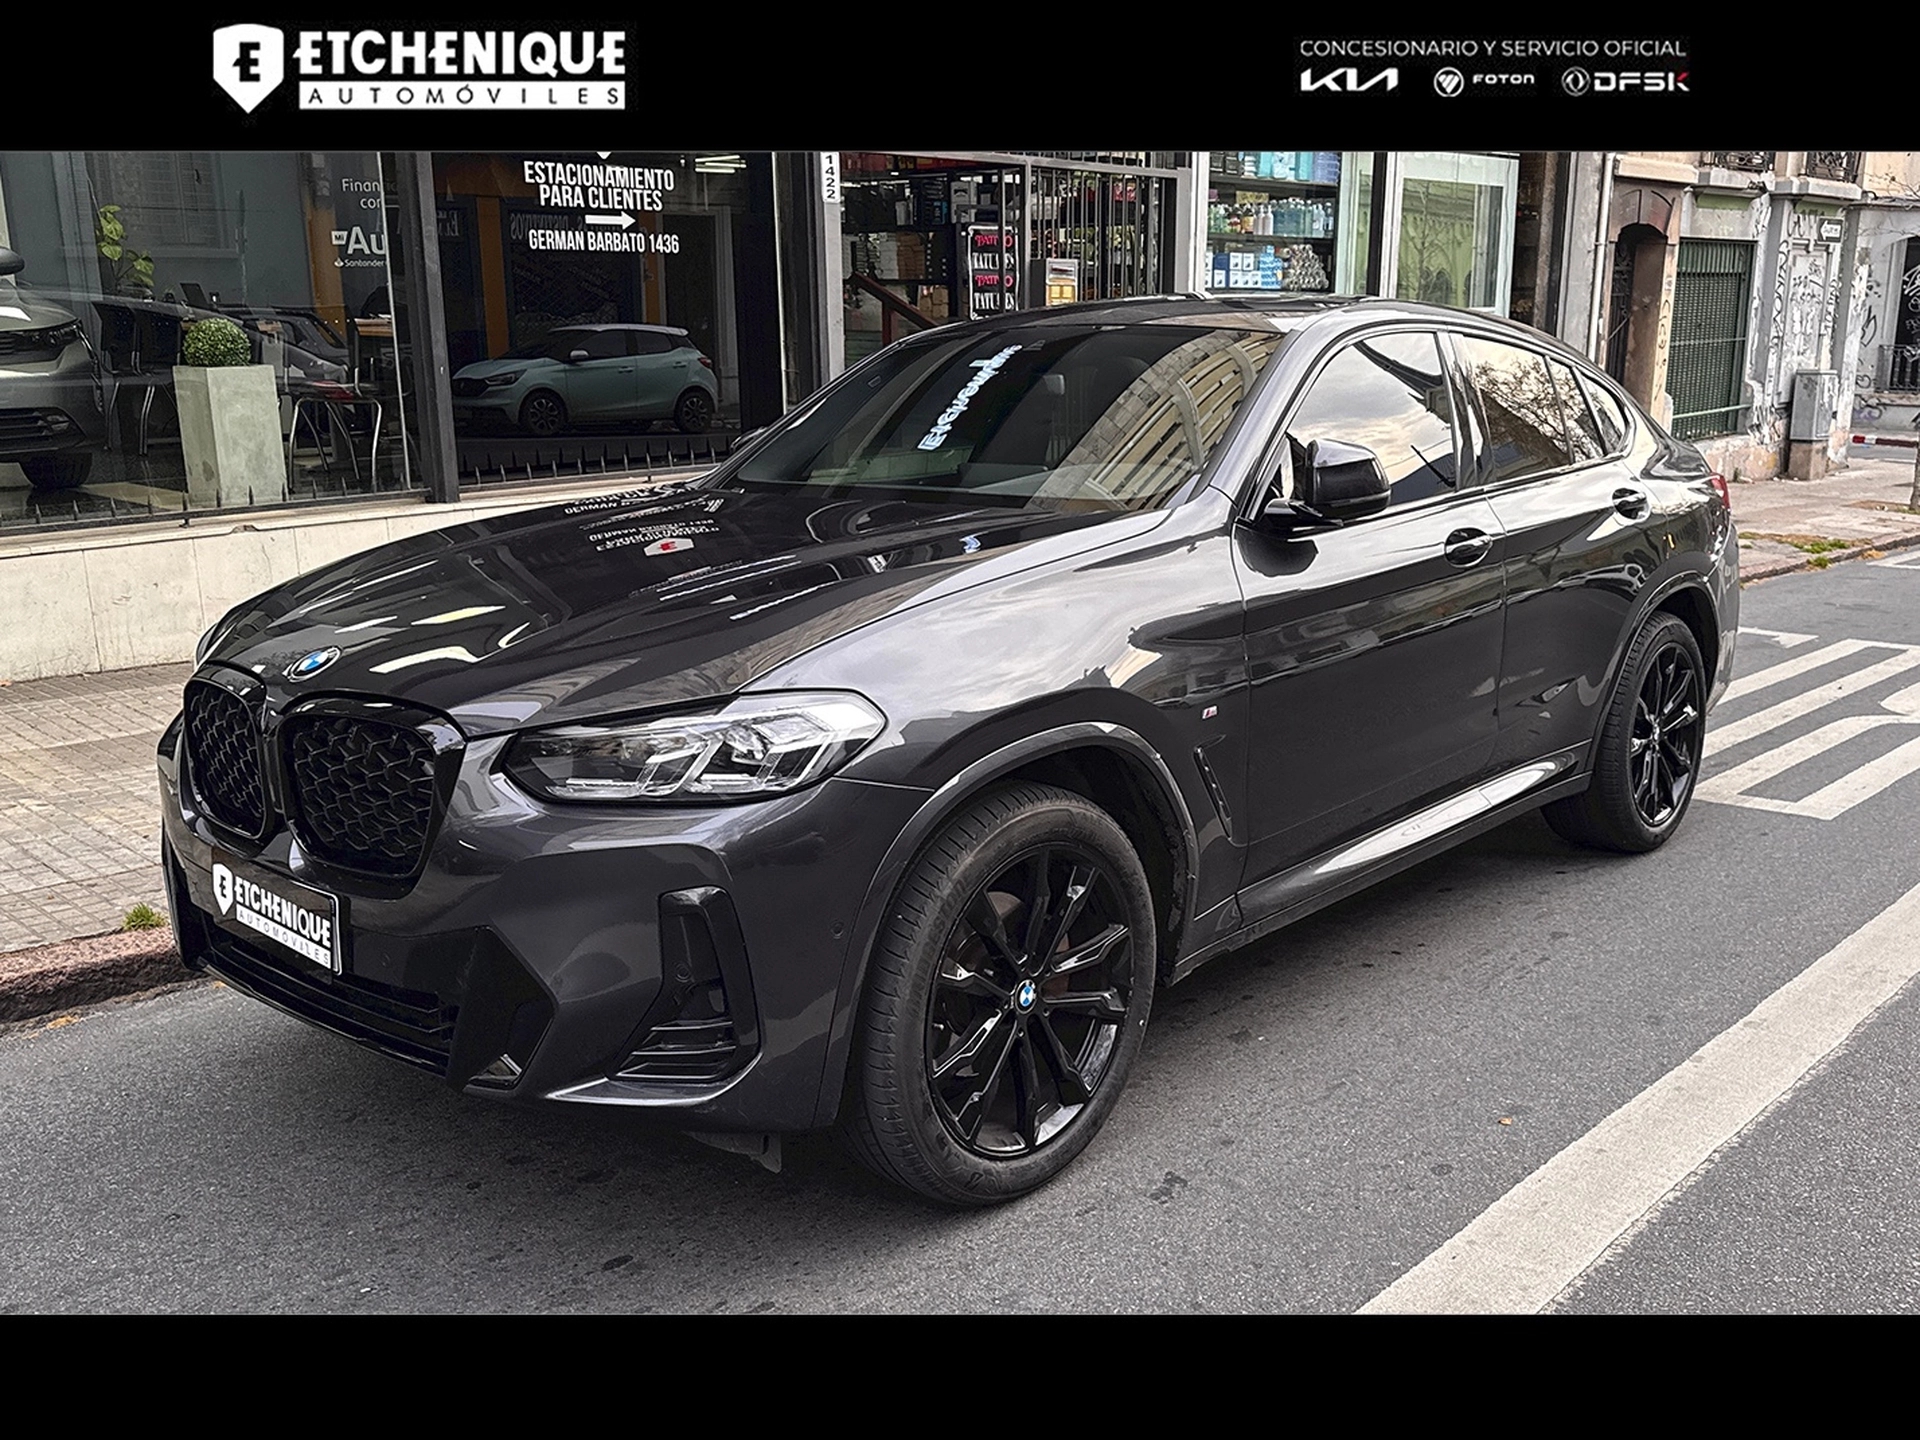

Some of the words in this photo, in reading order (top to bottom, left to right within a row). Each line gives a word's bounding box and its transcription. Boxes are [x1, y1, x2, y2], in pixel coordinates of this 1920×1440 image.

[523, 160, 675, 191] ESTACIONAMIENTO
[825, 154, 836, 199] 1422
[539, 183, 585, 208] PARA
[588, 186, 663, 212] CLIENTES
[347, 226, 387, 255] Au
[528, 229, 585, 251] GERMAN
[588, 231, 645, 253] BARBATO
[648, 233, 680, 255] 1436
